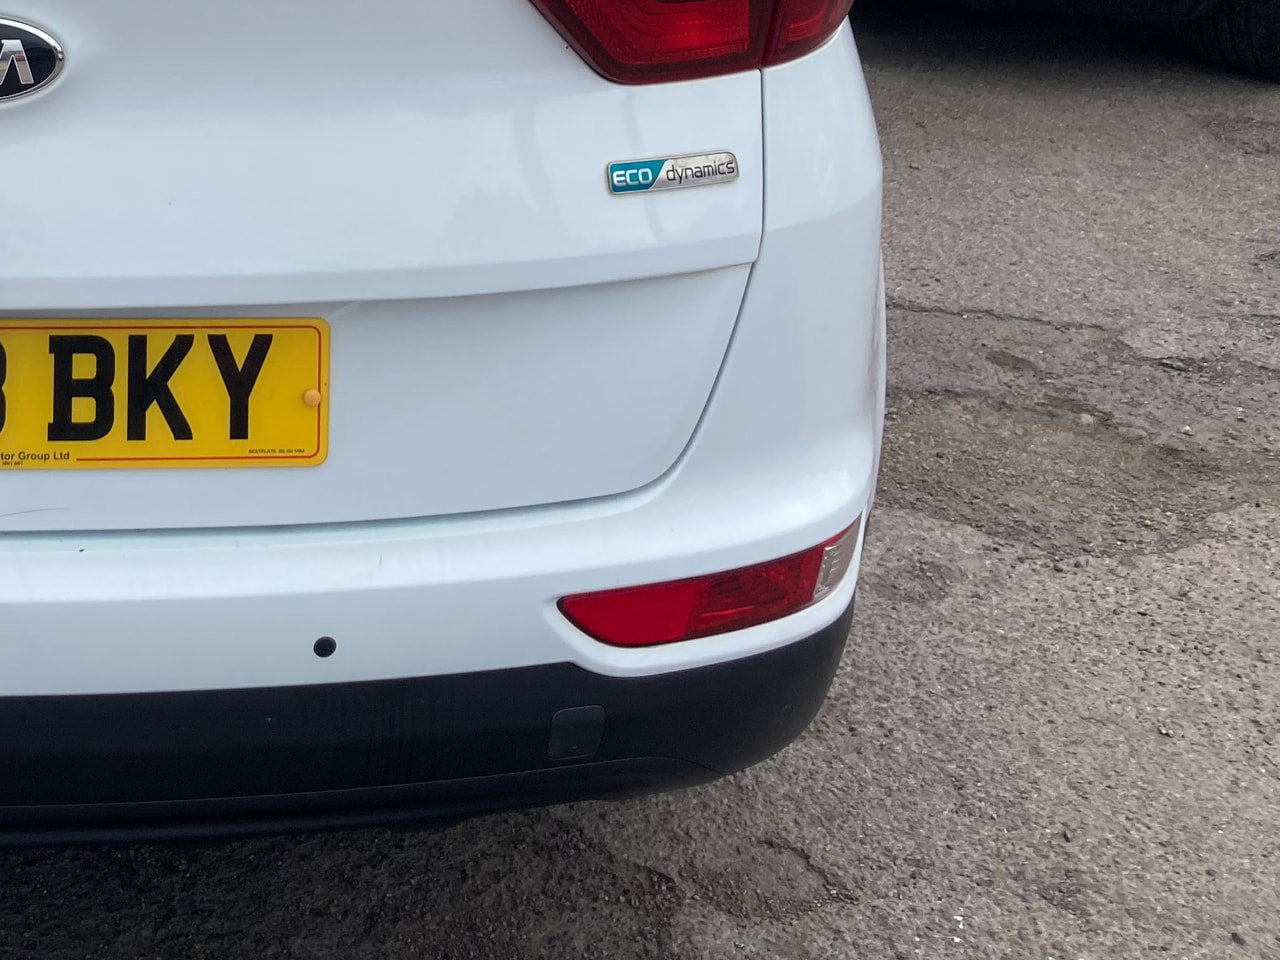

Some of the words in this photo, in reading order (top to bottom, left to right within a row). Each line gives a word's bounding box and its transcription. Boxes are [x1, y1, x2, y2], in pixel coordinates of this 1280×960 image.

[612, 167, 653, 187] ECO
[666, 160, 735, 185] dynamics
[47, 332, 274, 442] BKY
[18, 451, 50, 462] Group
[53, 451, 70, 460] Ltd
